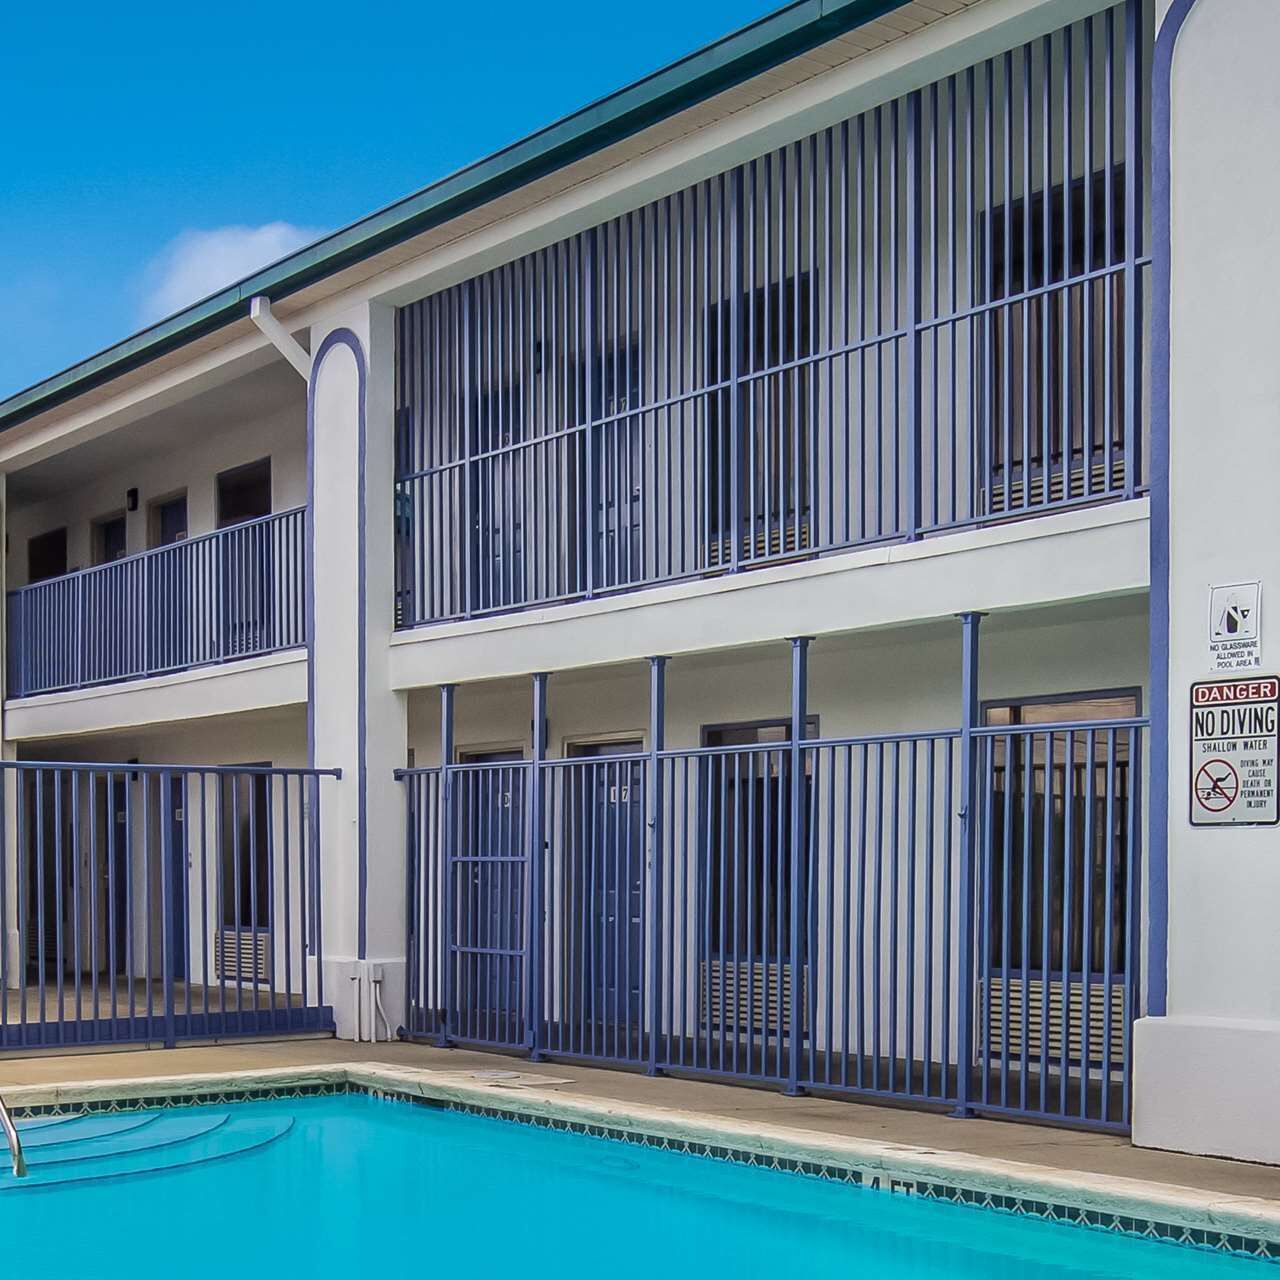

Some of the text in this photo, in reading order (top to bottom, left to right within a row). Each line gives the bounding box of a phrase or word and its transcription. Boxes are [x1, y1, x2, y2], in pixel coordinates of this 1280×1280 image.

[1221, 641, 1258, 650] GLASSWARE
[1216, 651, 1245, 660] ALLOWED
[1236, 659, 1252, 667] AREA
[1198, 683, 1271, 701] DANGER
[1195, 706, 1275, 737] NO DIVING
[1202, 740, 1267, 753] SHALLOW WATER
[1240, 758, 1273, 768] DIVING MAY
[1248, 769, 1265, 777] CAUSE
[1242, 778, 1271, 788] DEATH OR
[1240, 789, 1273, 798] PERMANENT
[1246, 800, 1266, 808] INJURY
